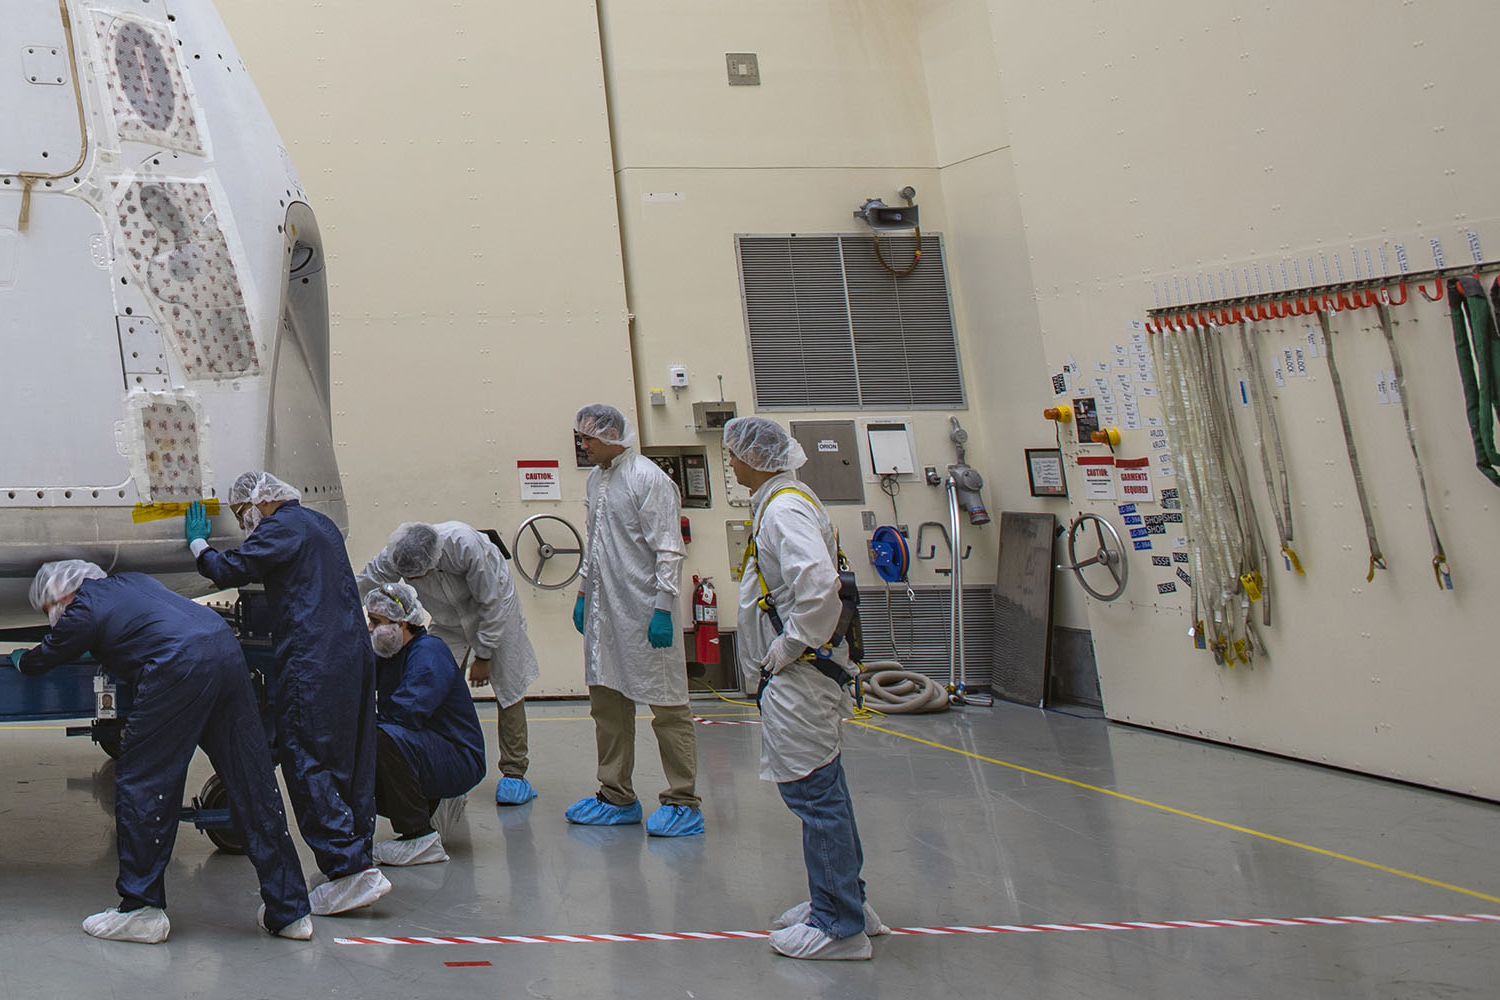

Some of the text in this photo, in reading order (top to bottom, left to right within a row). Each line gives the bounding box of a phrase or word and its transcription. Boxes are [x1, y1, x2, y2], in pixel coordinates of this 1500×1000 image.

[1284, 350, 1294, 373] AIRLOCK
[1296, 350, 1306, 372] AIRLOCK
[525, 472, 554, 480] CAUTION:
[1120, 472, 1148, 481] GARMENTS
[1124, 486, 1148, 494] REQUIRED
[1145, 516, 1162, 524] SHOP
[1162, 514, 1182, 522] SHED
[1147, 525, 1165, 534] SHOP
[1153, 557, 1170, 566] NSSF
[1173, 553, 1188, 562] NSS
[1158, 583, 1176, 594] NSSF
